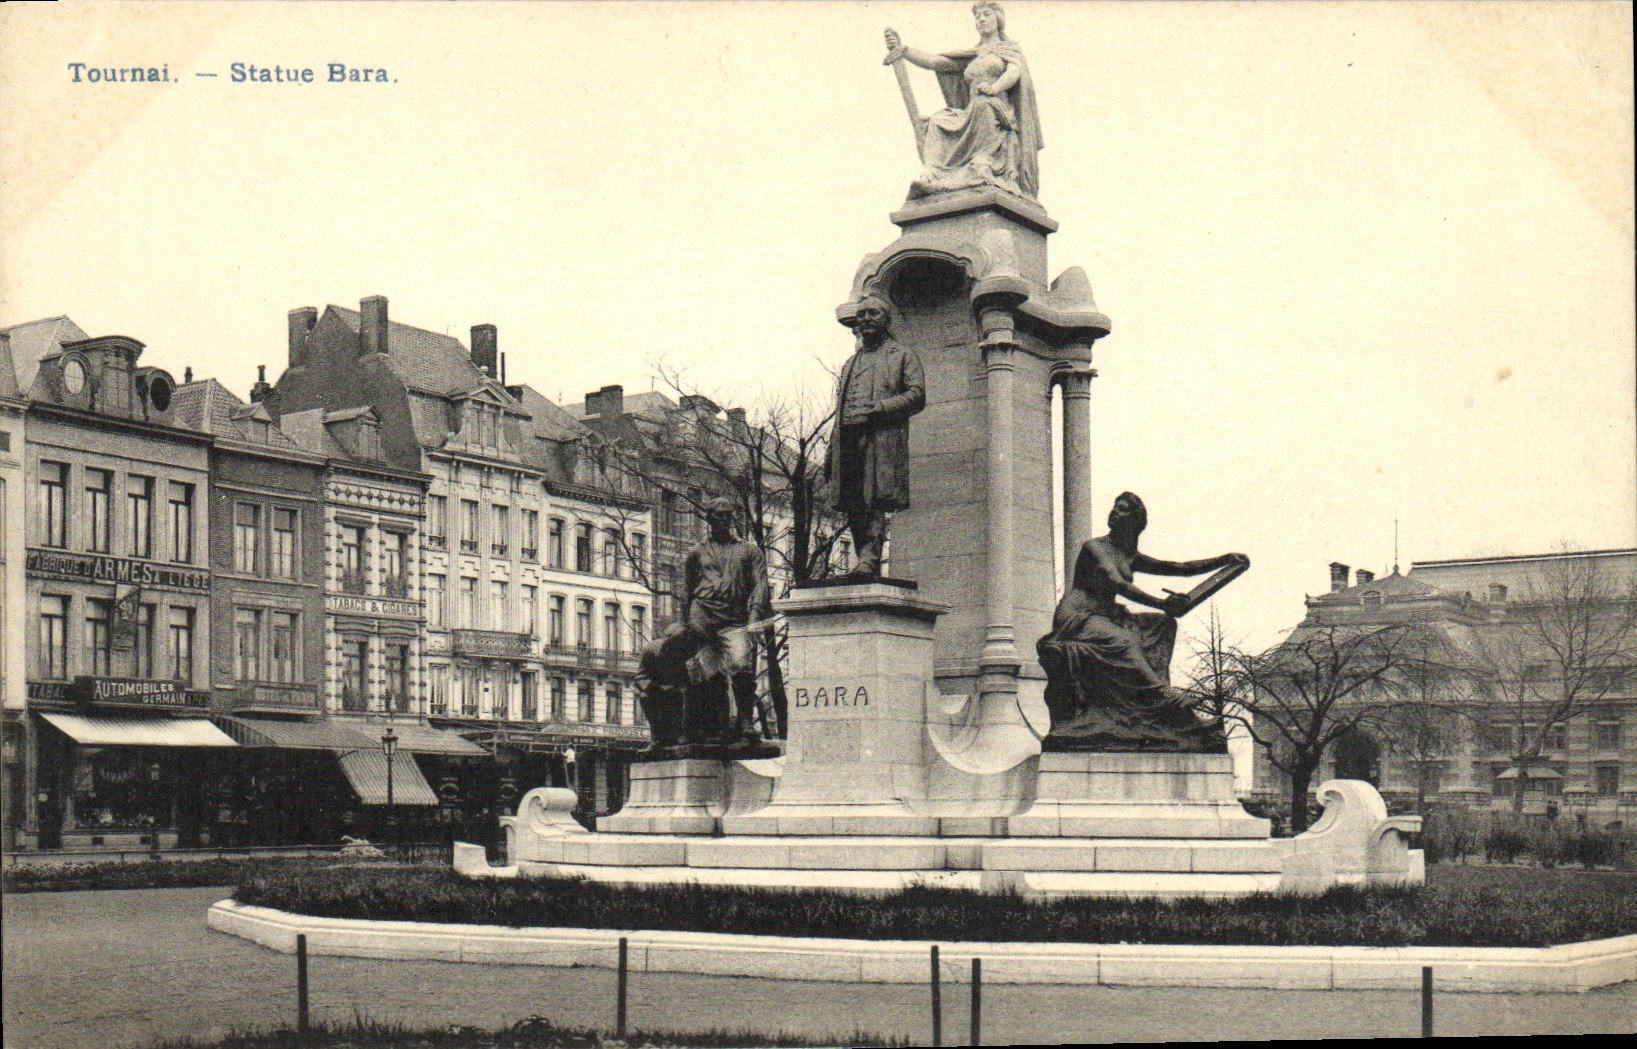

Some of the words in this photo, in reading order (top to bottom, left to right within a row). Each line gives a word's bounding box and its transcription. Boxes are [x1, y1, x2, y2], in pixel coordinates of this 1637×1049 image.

[334, 597, 366, 611] TABACS
[371, 602, 379, 612] &
[382, 602, 417, 616] CIGARES
[93, 679, 174, 700] AUTOMOBILES
[142, 693, 186, 705] GERMAIN
[796, 686, 869, 708] BARA
